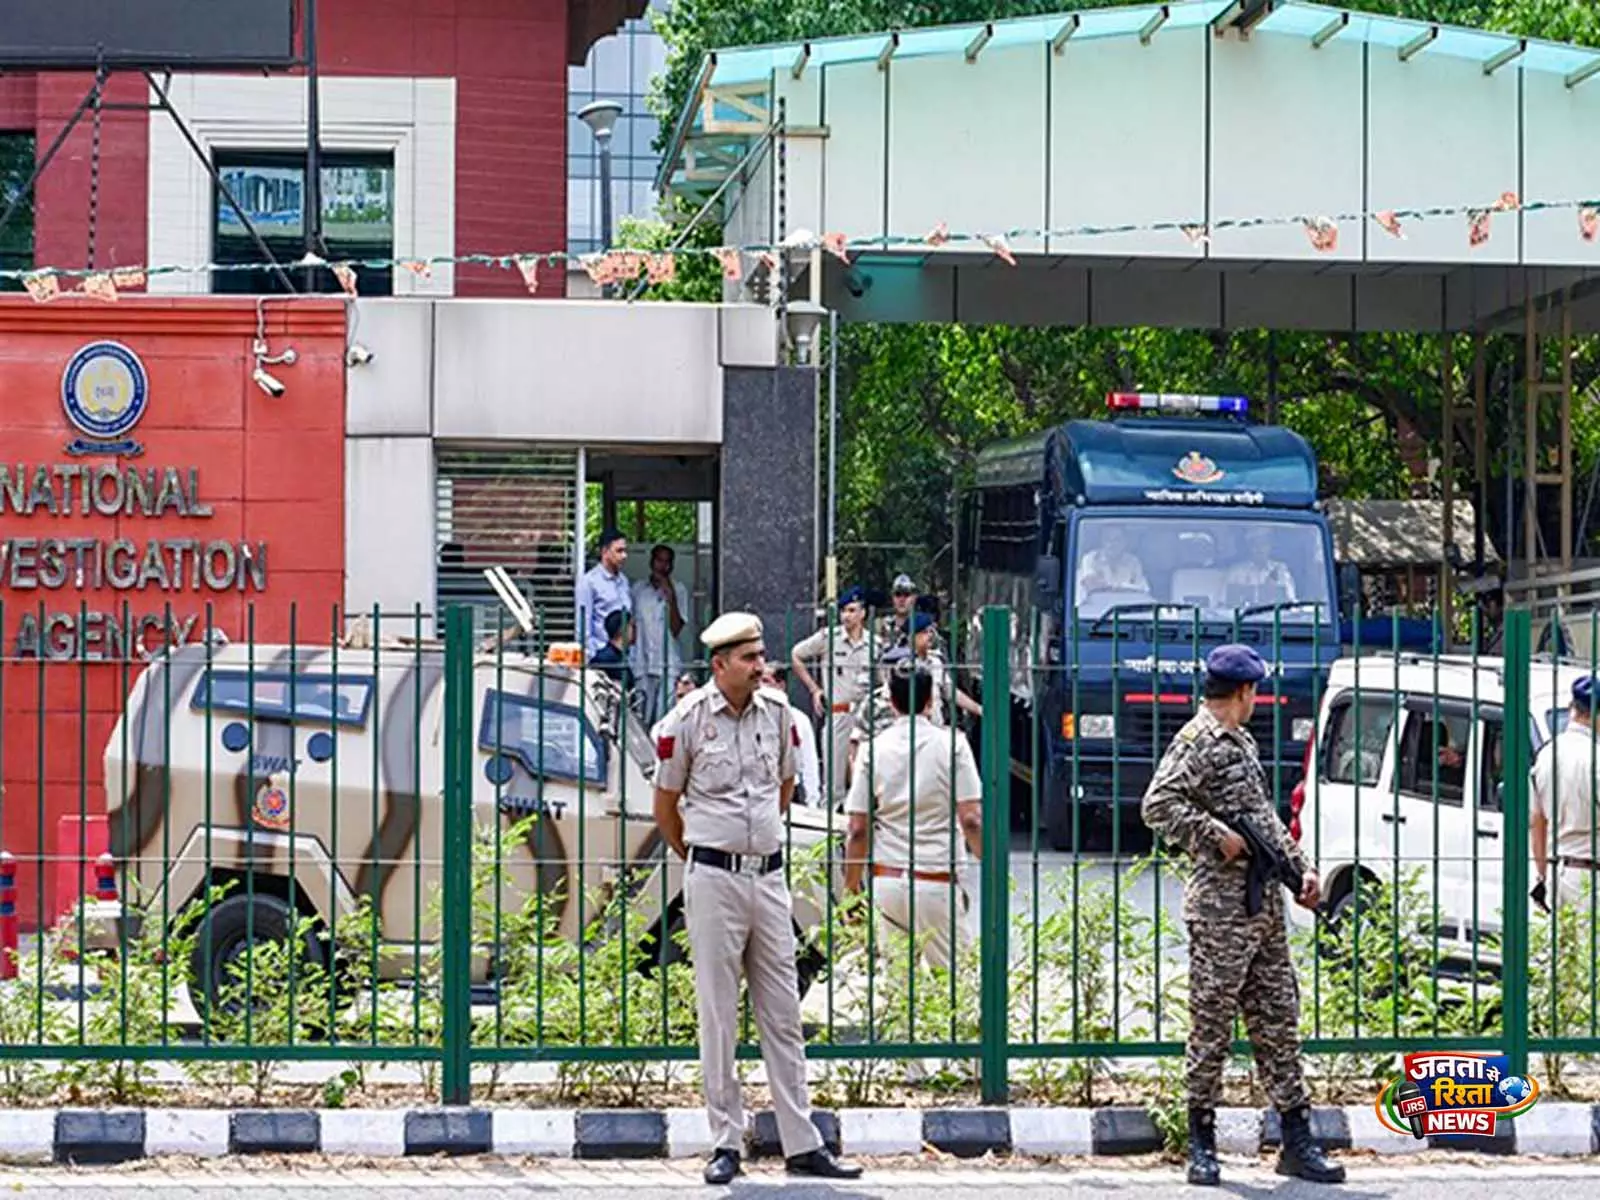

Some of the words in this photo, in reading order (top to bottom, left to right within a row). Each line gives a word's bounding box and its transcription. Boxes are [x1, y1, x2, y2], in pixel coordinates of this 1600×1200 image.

[0, 464, 213, 516] NATIONAL
[15, 611, 198, 661] AGENCY
[249, 755, 303, 773] SWAT
[499, 796, 567, 820] SWAT
